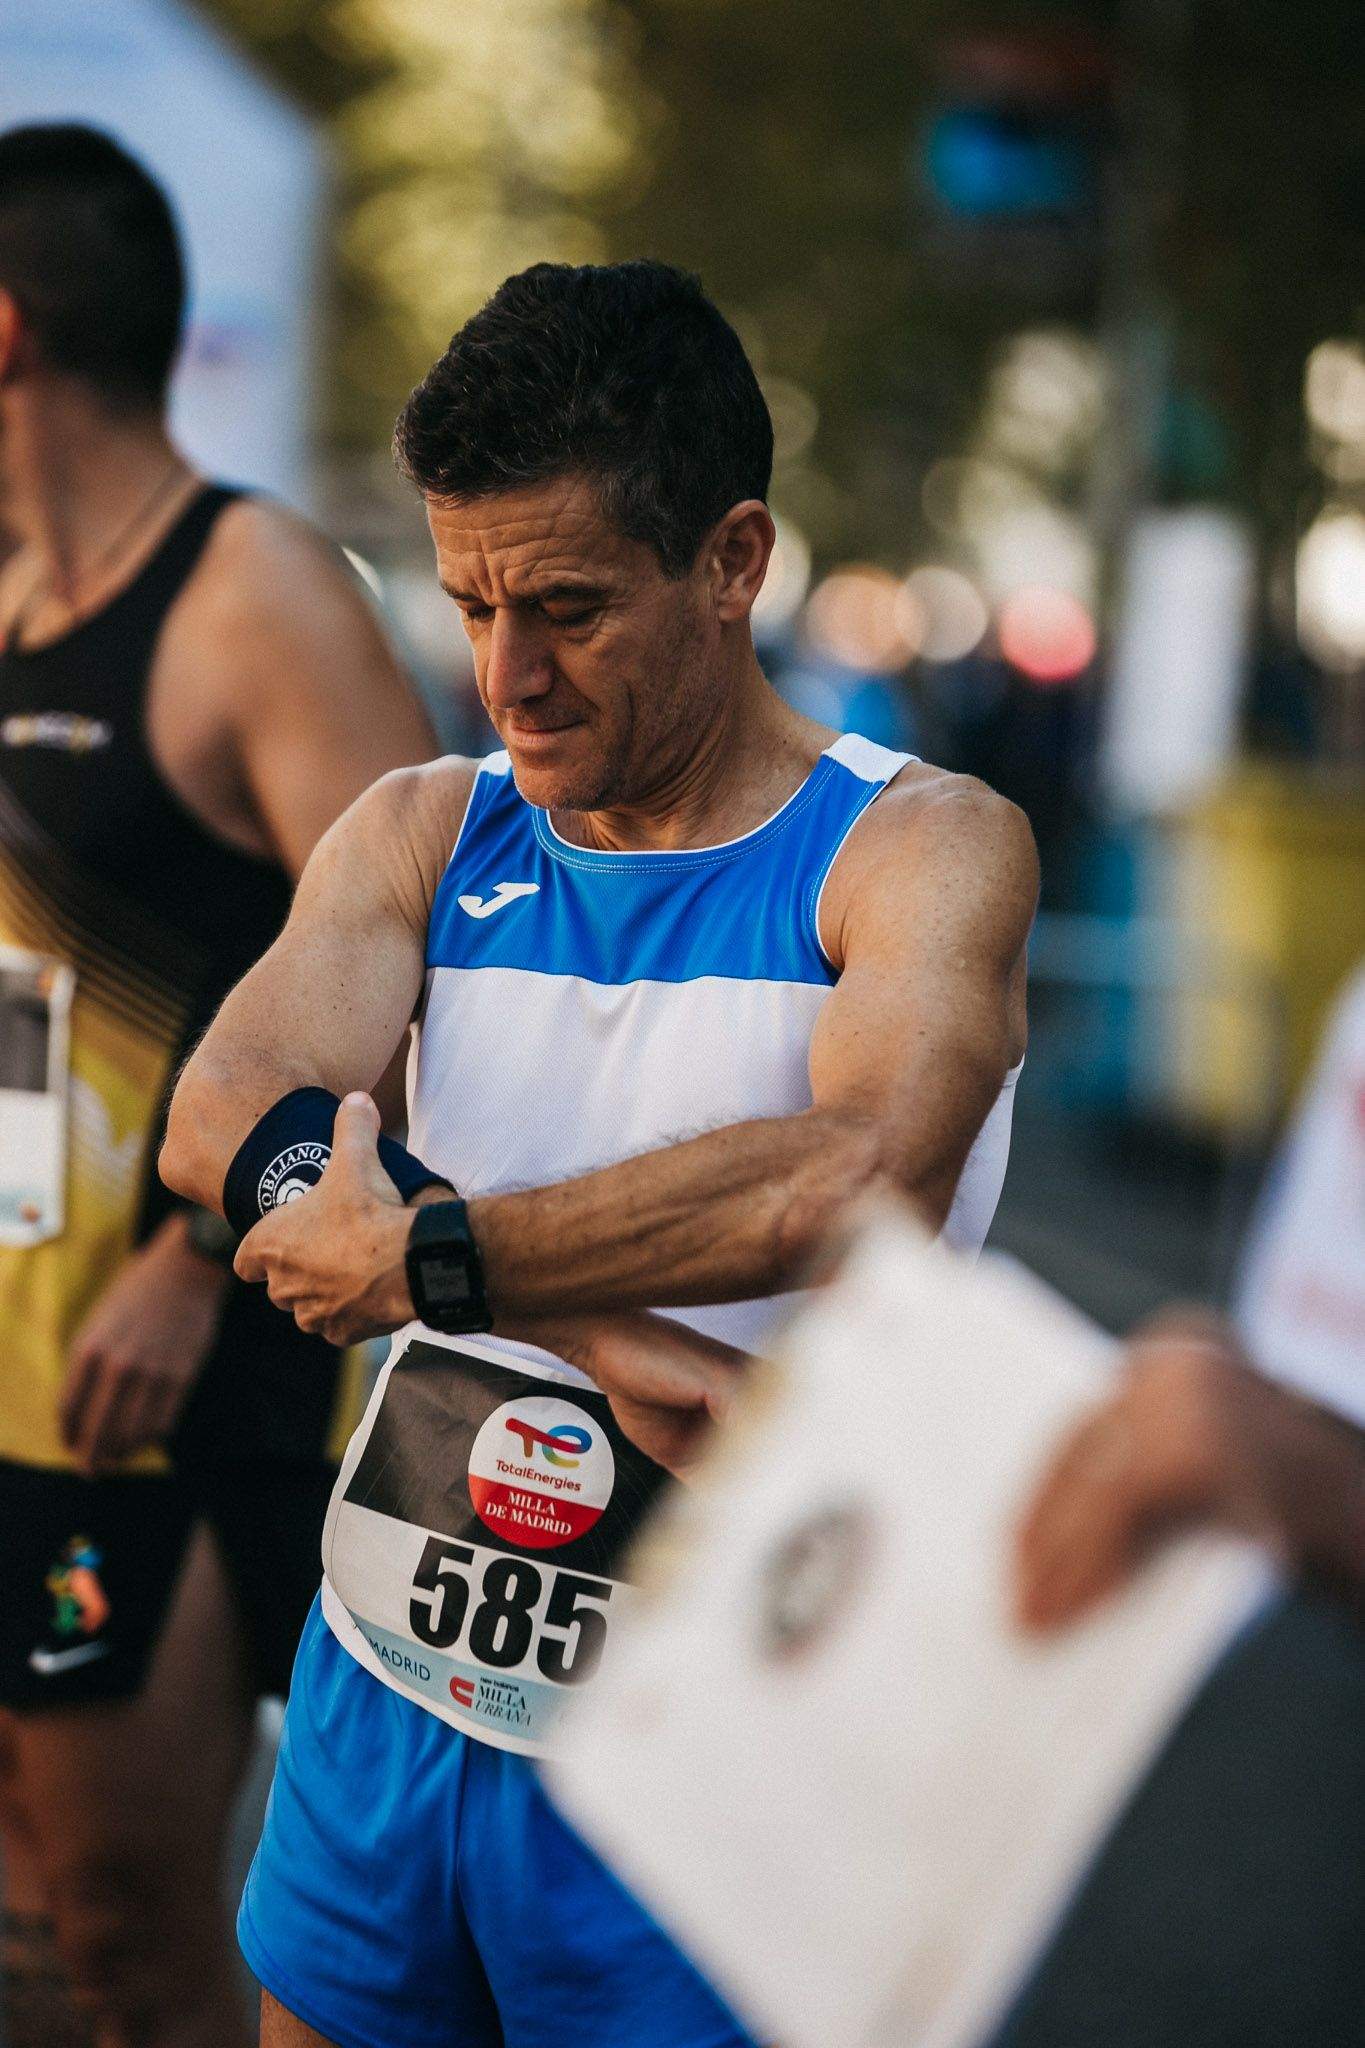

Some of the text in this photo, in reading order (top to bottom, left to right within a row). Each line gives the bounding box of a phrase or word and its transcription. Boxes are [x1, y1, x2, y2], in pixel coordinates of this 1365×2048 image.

[262, 1147, 322, 1212] OBLIANO
[496, 1459, 582, 1492] TotalEnergies
[485, 1502, 572, 1536] DE MADRID
[508, 1491, 556, 1516] MILLA
[409, 1536, 613, 1685] 585
[475, 1700, 531, 1727] URBANA
[480, 1685, 526, 1710] MILLA
